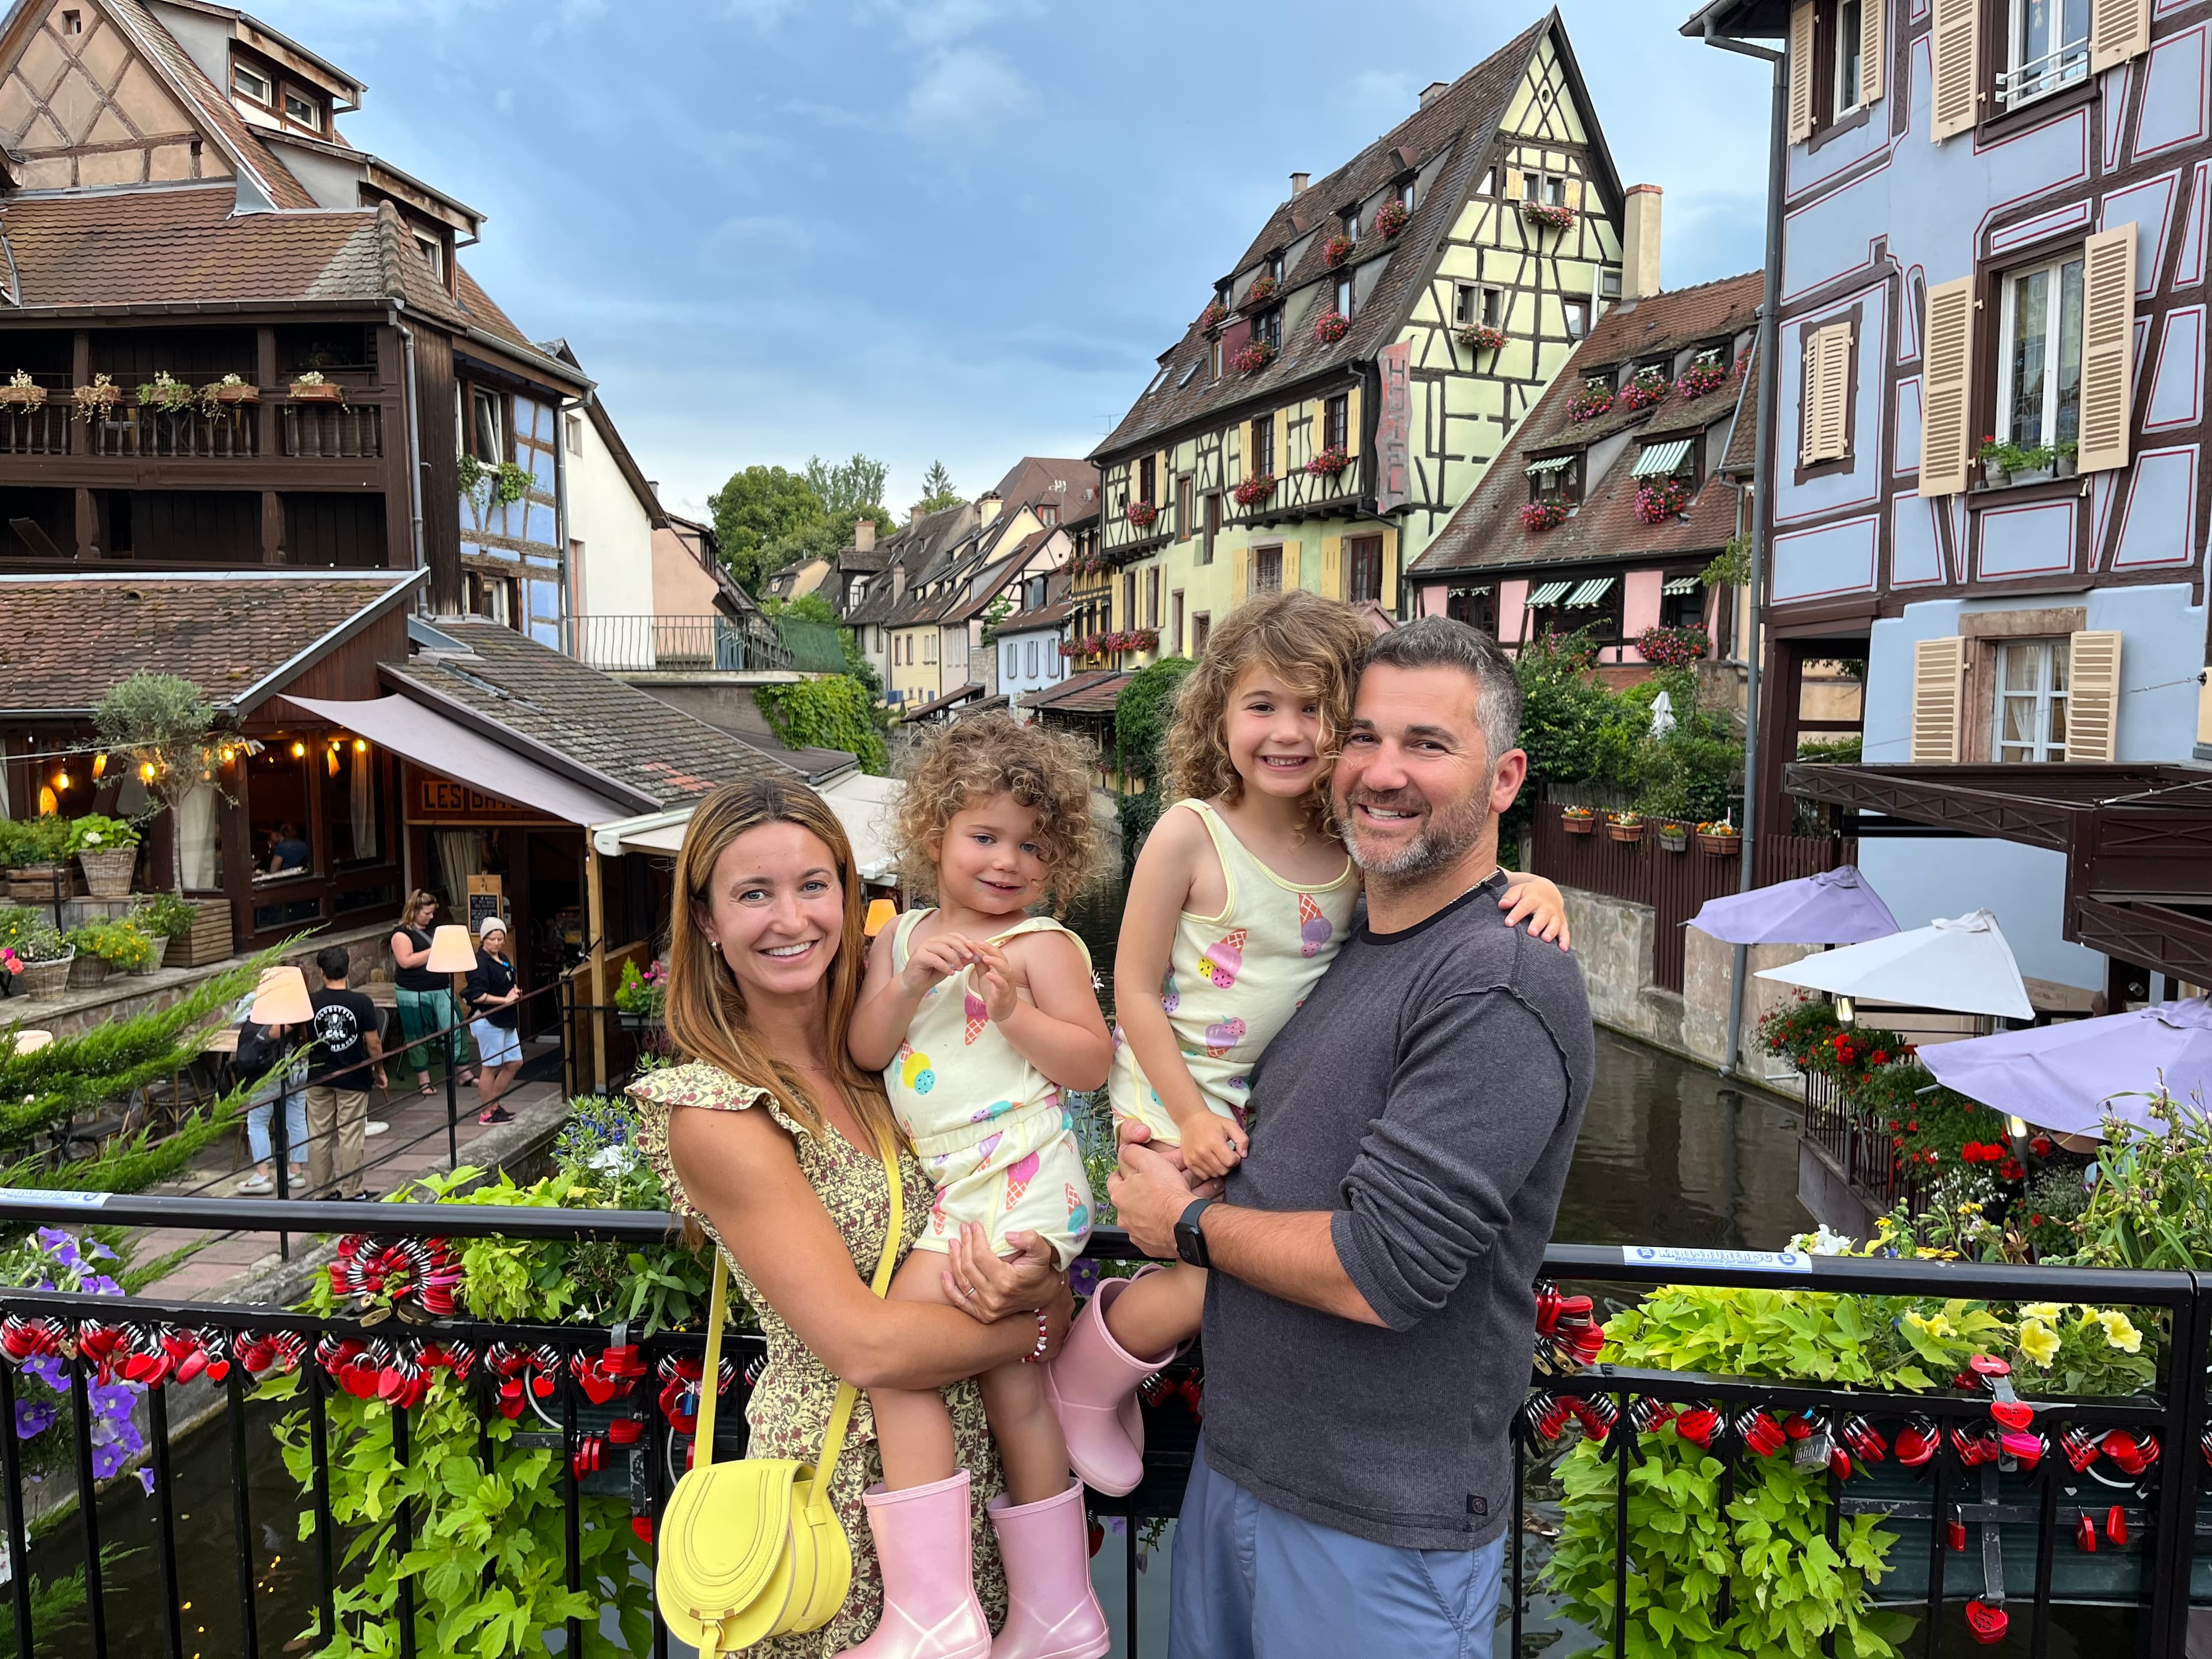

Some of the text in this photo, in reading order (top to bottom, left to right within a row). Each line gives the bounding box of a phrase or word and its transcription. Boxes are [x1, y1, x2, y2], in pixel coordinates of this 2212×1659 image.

[1387, 358, 1406, 495] HOTEL
[424, 783, 461, 808] LES
[1751, 1252, 1772, 1262] SC
